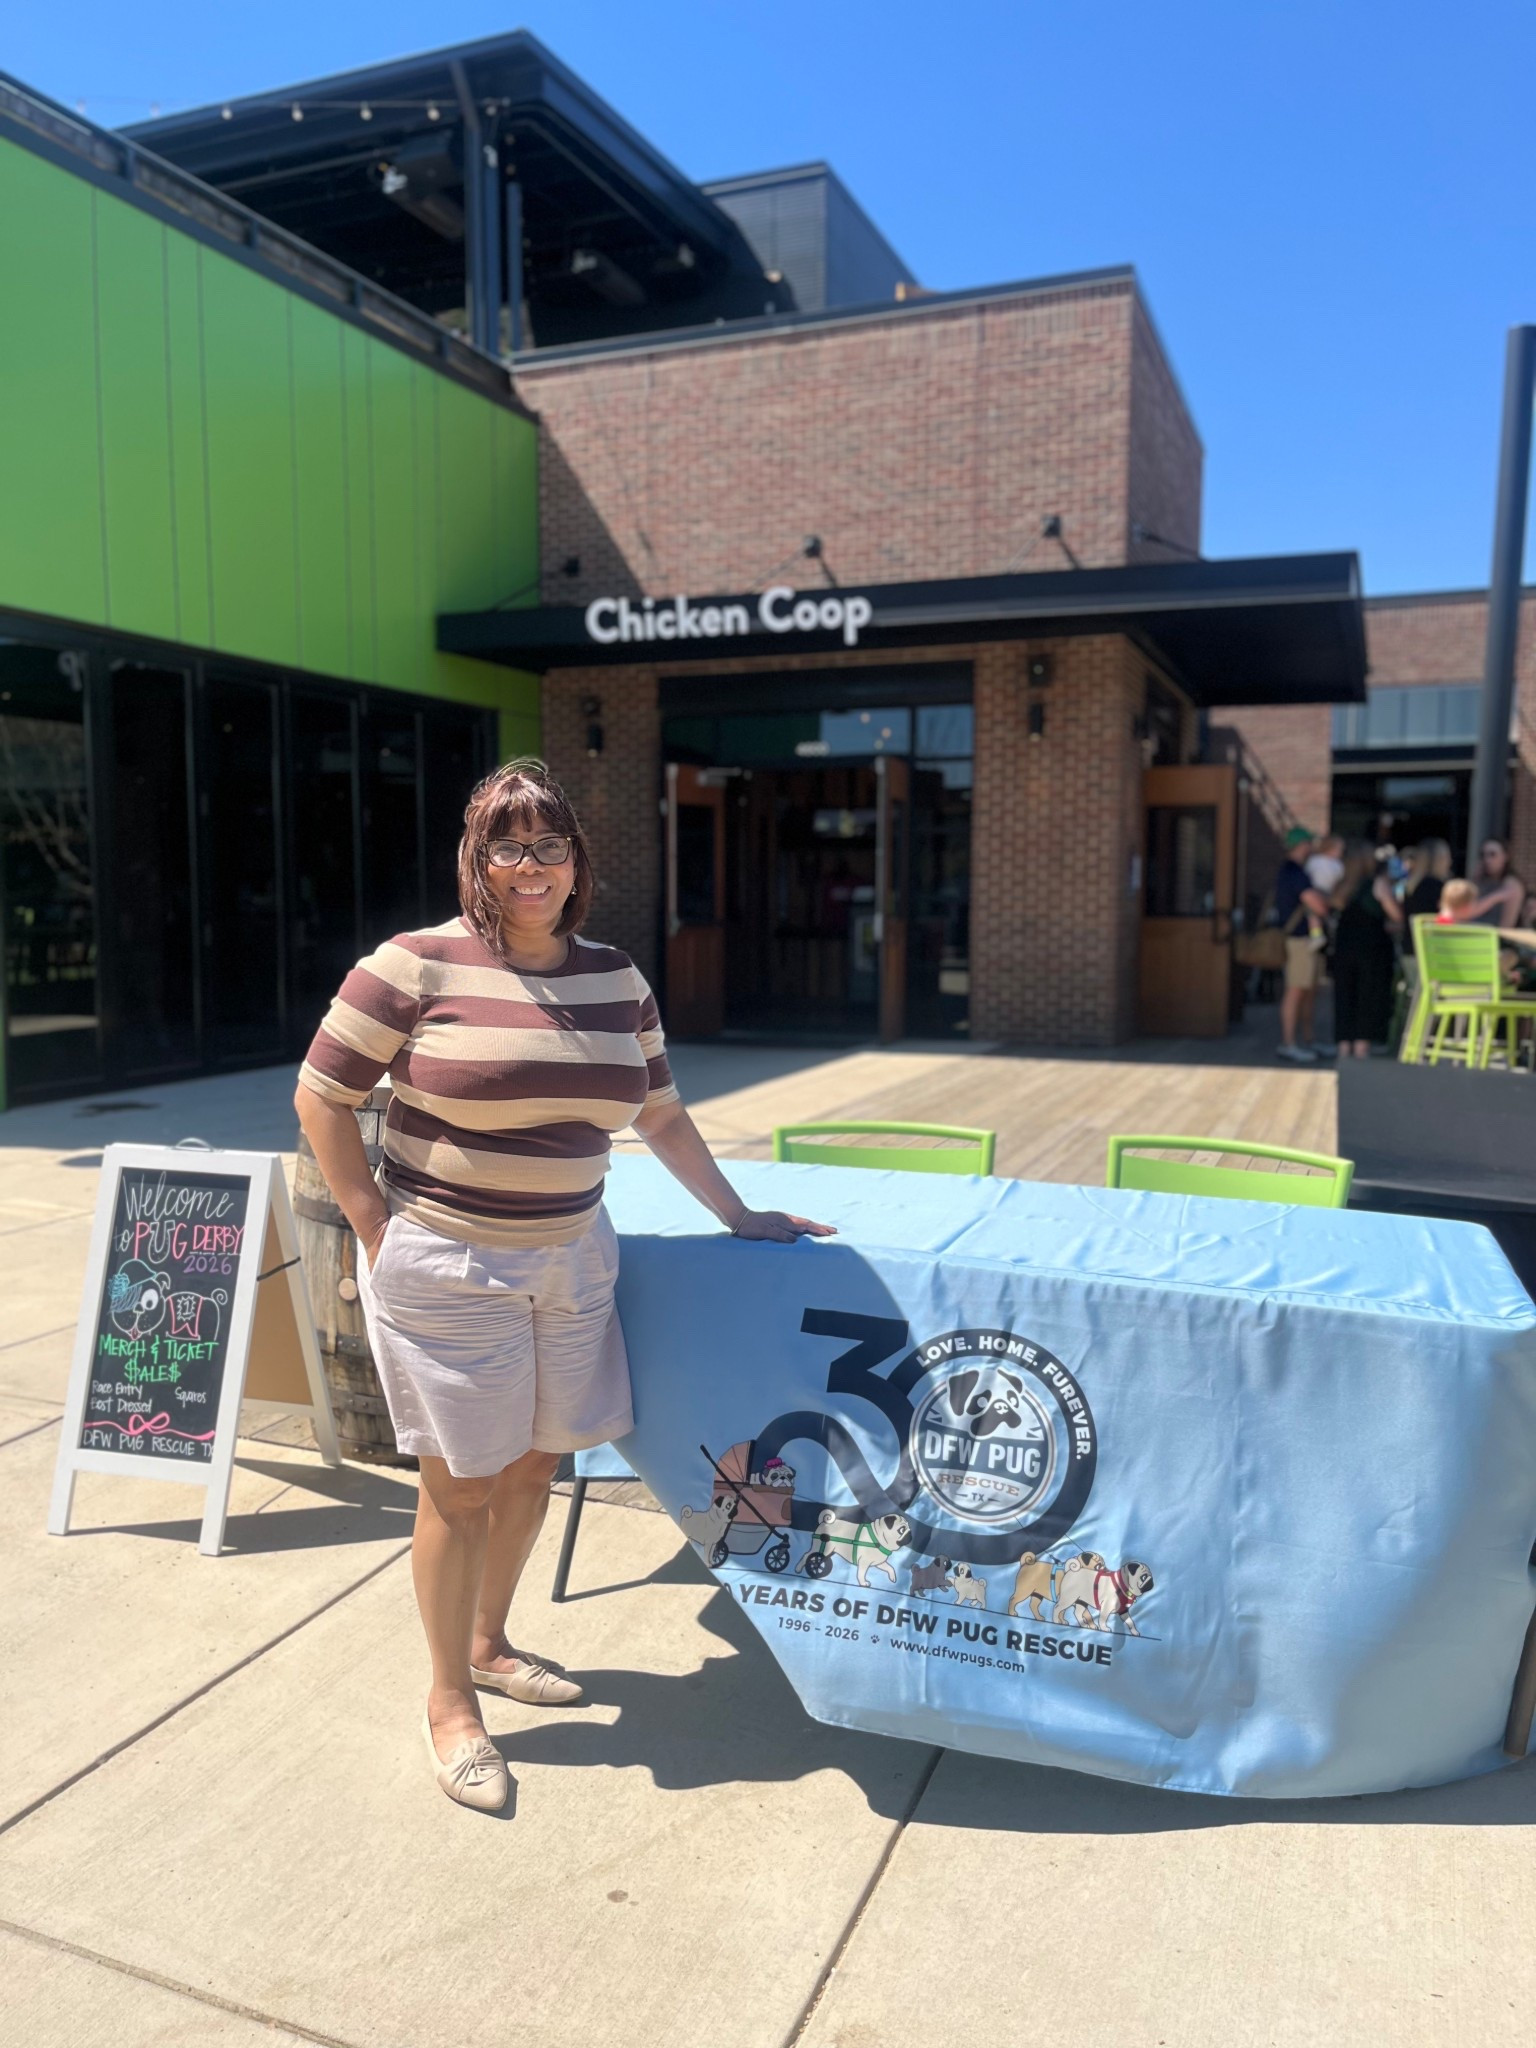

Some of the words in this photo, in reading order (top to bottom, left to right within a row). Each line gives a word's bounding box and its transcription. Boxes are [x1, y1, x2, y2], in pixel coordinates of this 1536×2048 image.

[585, 594, 750, 644] Chicken
[758, 585, 872, 647] Coop
[122, 1170, 235, 1222] Welcome
[113, 1225, 135, 1252] to
[134, 1219, 188, 1264] PUG
[192, 1224, 246, 1255] DERBY
[183, 1255, 232, 1275] 2026
[182, 1301, 192, 1316] 1
[99, 1333, 146, 1361] MERCH
[150, 1334, 160, 1364] &
[163, 1339, 219, 1362] TICKET
[92, 1380, 114, 1395] Race
[115, 1382, 143, 1400] Entry
[174, 1386, 207, 1408] Squares
[916, 1336, 973, 1368] LOVE.
[978, 1335, 1038, 1367] HOME.
[1042, 1361, 1092, 1460] FUREVER.
[90, 1397, 114, 1413] Best
[117, 1398, 153, 1413] Dressed
[83, 1429, 112, 1448] DFW
[119, 1434, 144, 1450] PUG
[151, 1436, 196, 1456] RESCUE
[924, 1429, 981, 1467] DFW
[987, 1443, 1041, 1478] PUG
[938, 1473, 1020, 1497] RESCUE
[972, 1492, 986, 1503] TX
[739, 1583, 825, 1614] YEARS
[832, 1597, 869, 1620] OF
[876, 1604, 939, 1635] DFW
[946, 1618, 998, 1646] PUG
[1006, 1629, 1112, 1666] RESCUE
[777, 1616, 811, 1633] 1996
[824, 1624, 860, 1642] 2026
[890, 1637, 1025, 1674] www.dfwpugs.com
